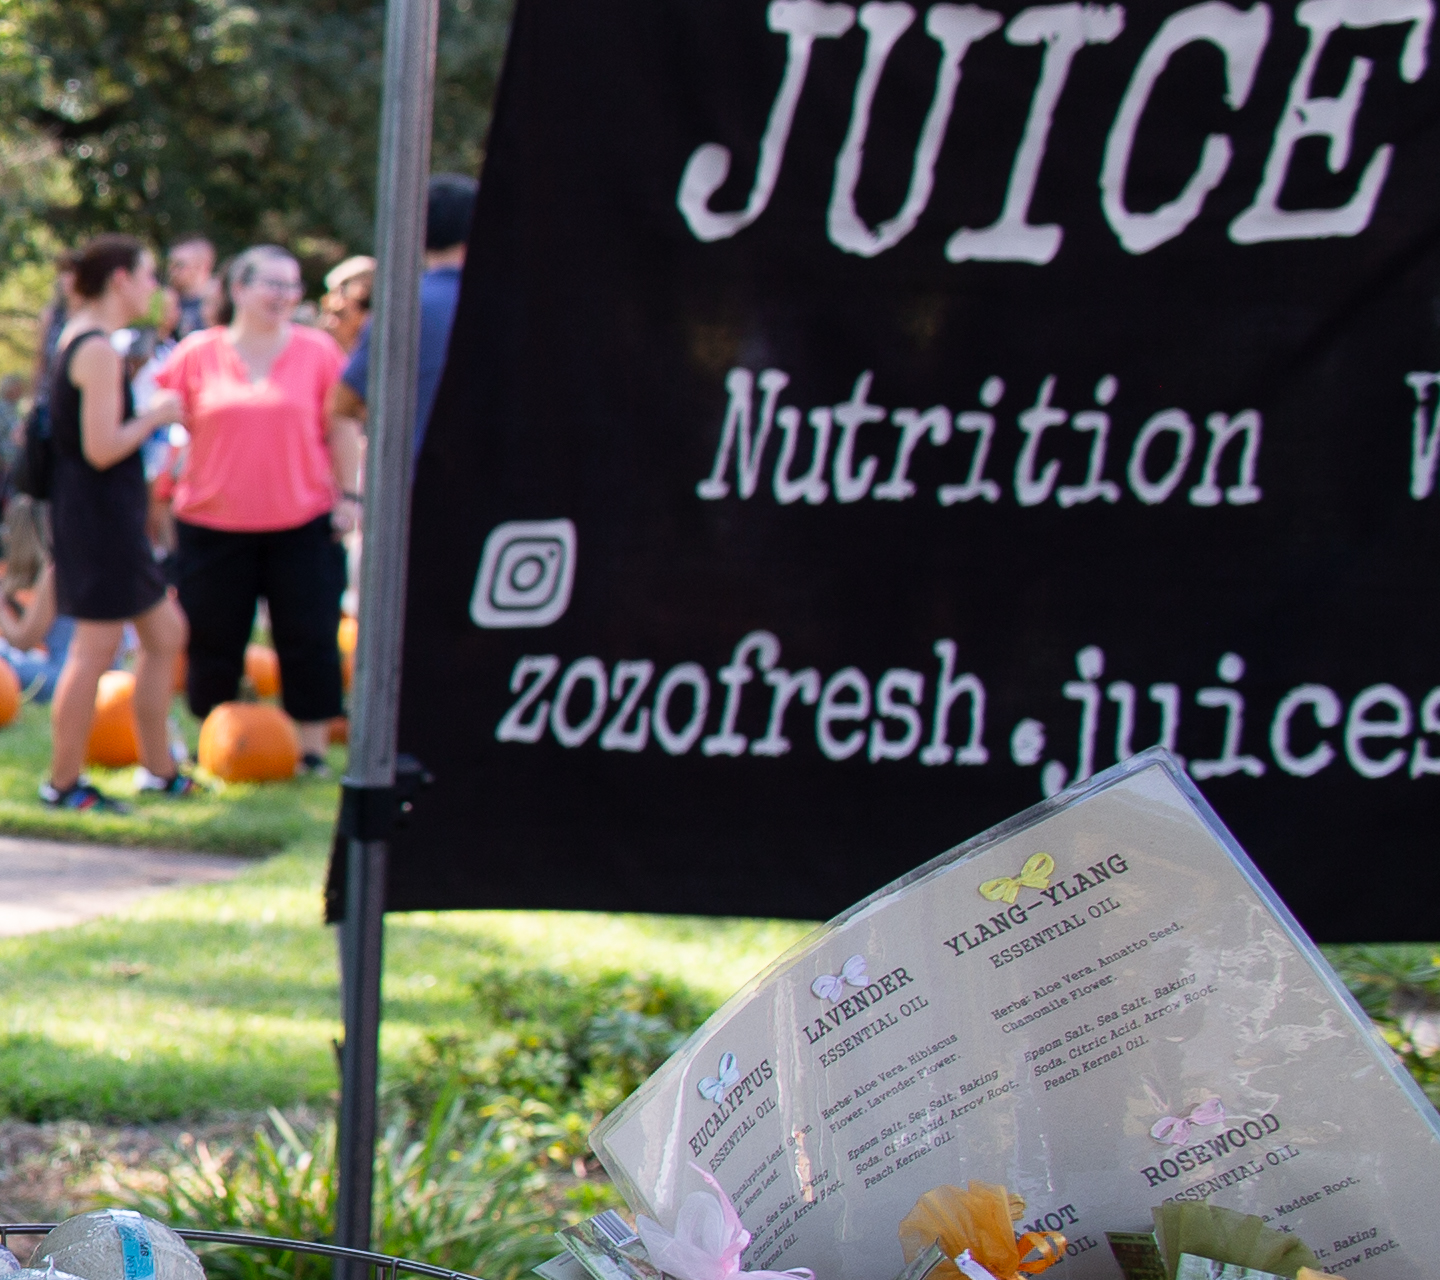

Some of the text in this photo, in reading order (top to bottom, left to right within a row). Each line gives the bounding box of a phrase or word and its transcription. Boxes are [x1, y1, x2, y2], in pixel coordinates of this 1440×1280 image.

[697, 368, 1262, 507] Nutrition
[944, 853, 1129, 956] YLANG-YLANG
[989, 896, 1121, 969] ESSENTIAL OIL
[1033, 980, 1062, 1000] Aloe
[1097, 939, 1148, 968] Annatto
[803, 967, 914, 1044] LAVENDER
[818, 996, 929, 1068] ESSENTIAL OIL
[1002, 997, 1068, 1034] Chamomile
[1023, 972, 1196, 1062] Epsom Sea Baking
[1069, 1037, 1108, 1060] Citric
[1144, 1003, 1180, 1024] Arrow
[854, 1034, 958, 1098] Aloe Hibiscus
[868, 1075, 916, 1108] Lavender
[1044, 1068, 1079, 1090] Peach
[1081, 1047, 1123, 1072] Kernel
[688, 1059, 774, 1158] EUCALYPTUS
[708, 1097, 776, 1172] ESSENTIAL OIL
[848, 1136, 879, 1161] Epsom
[959, 1070, 998, 1095] Baking
[950, 1097, 984, 1119] Arrow
[864, 1165, 893, 1189] Peach
[895, 1143, 931, 1169] Kernel
[1140, 1113, 1280, 1187] ROSEWOOD
[1265, 1144, 1300, 1166] OIL
[1275, 1192, 1321, 1216] Madder
[1334, 1226, 1377, 1251] Baking
